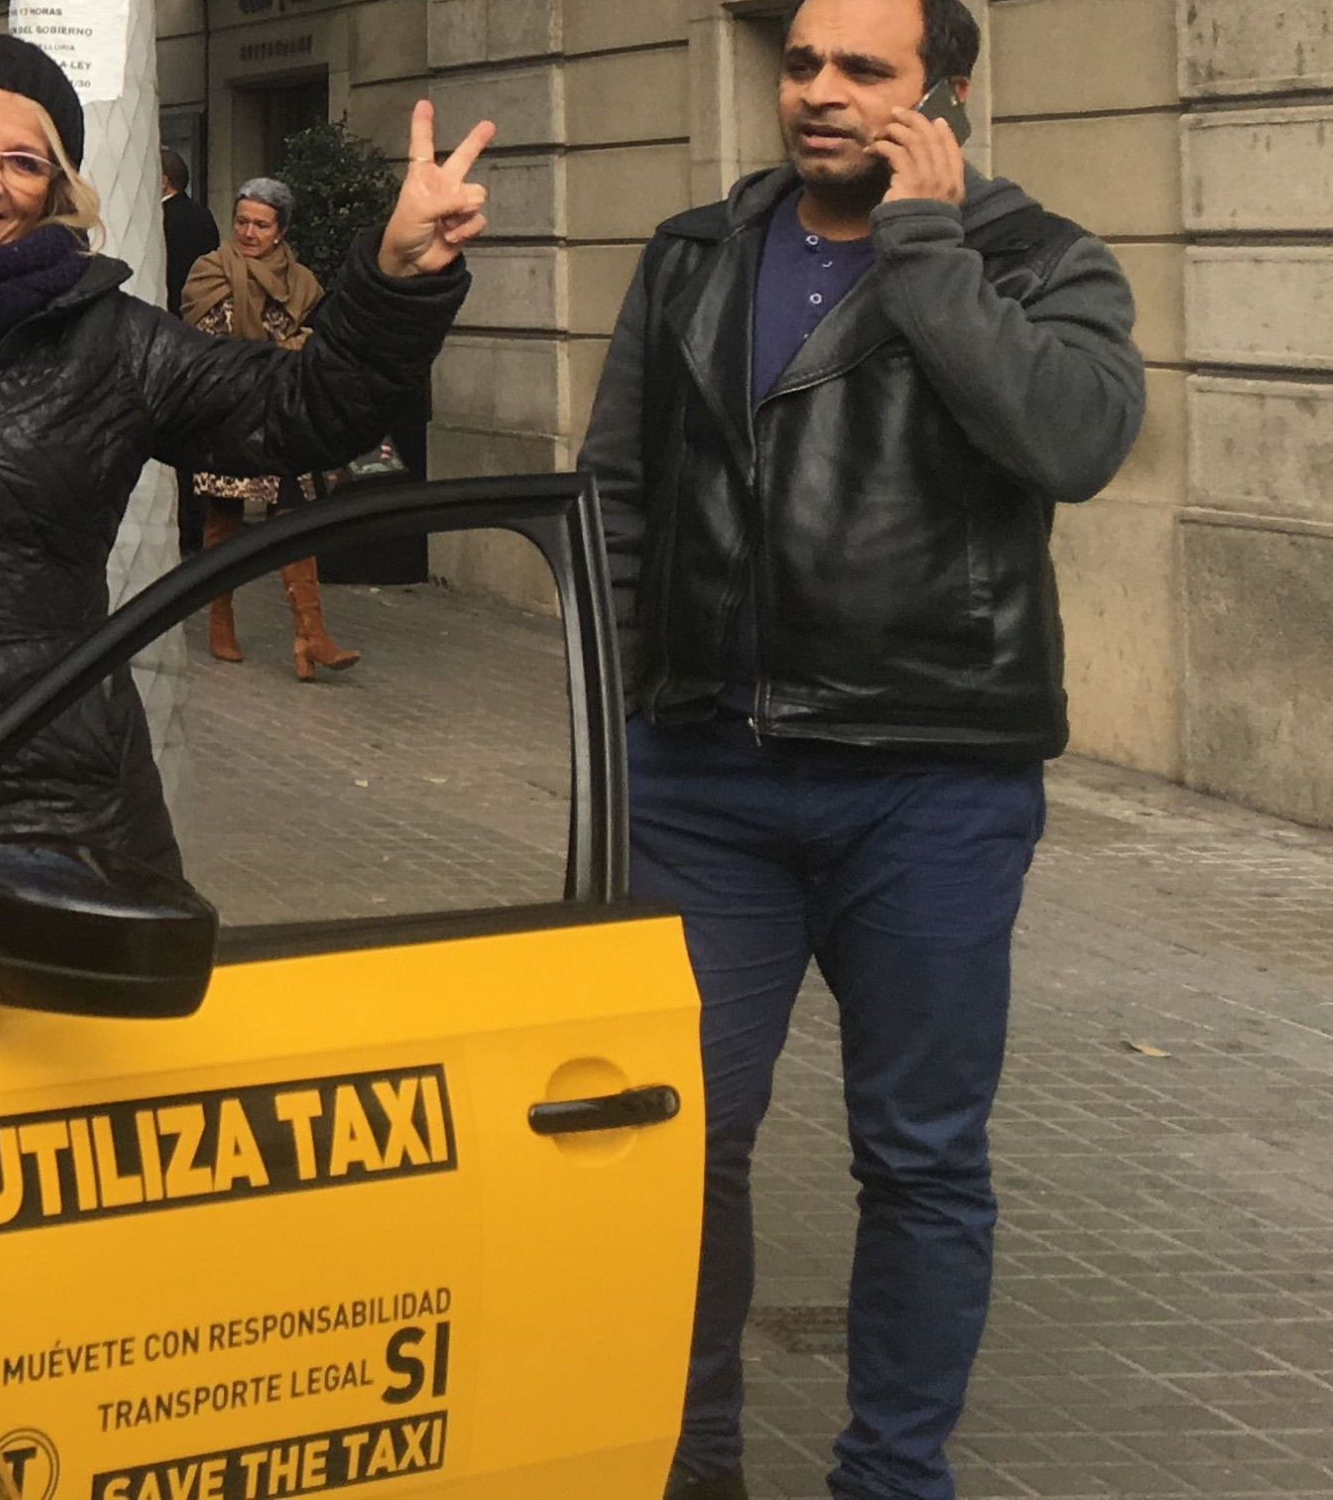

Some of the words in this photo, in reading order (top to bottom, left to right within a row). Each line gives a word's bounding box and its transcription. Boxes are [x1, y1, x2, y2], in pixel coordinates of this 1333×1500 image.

[29, 8, 63, 16] HORAS
[36, 25, 93, 37] GOBIERNO
[70, 61, 92, 70] LEY
[274, 1074, 450, 1183] TAXI
[2, 1338, 136, 1387] MUÉVETE
[144, 1326, 200, 1363] CON
[208, 1286, 452, 1352] RESPONSABILIDAD
[97, 1373, 282, 1433] TRANSPORTE
[290, 1358, 375, 1400] LEGAL
[380, 1319, 451, 1406] SI
[239, 1438, 331, 1500] THE
[342, 1418, 444, 1481] TAXI
